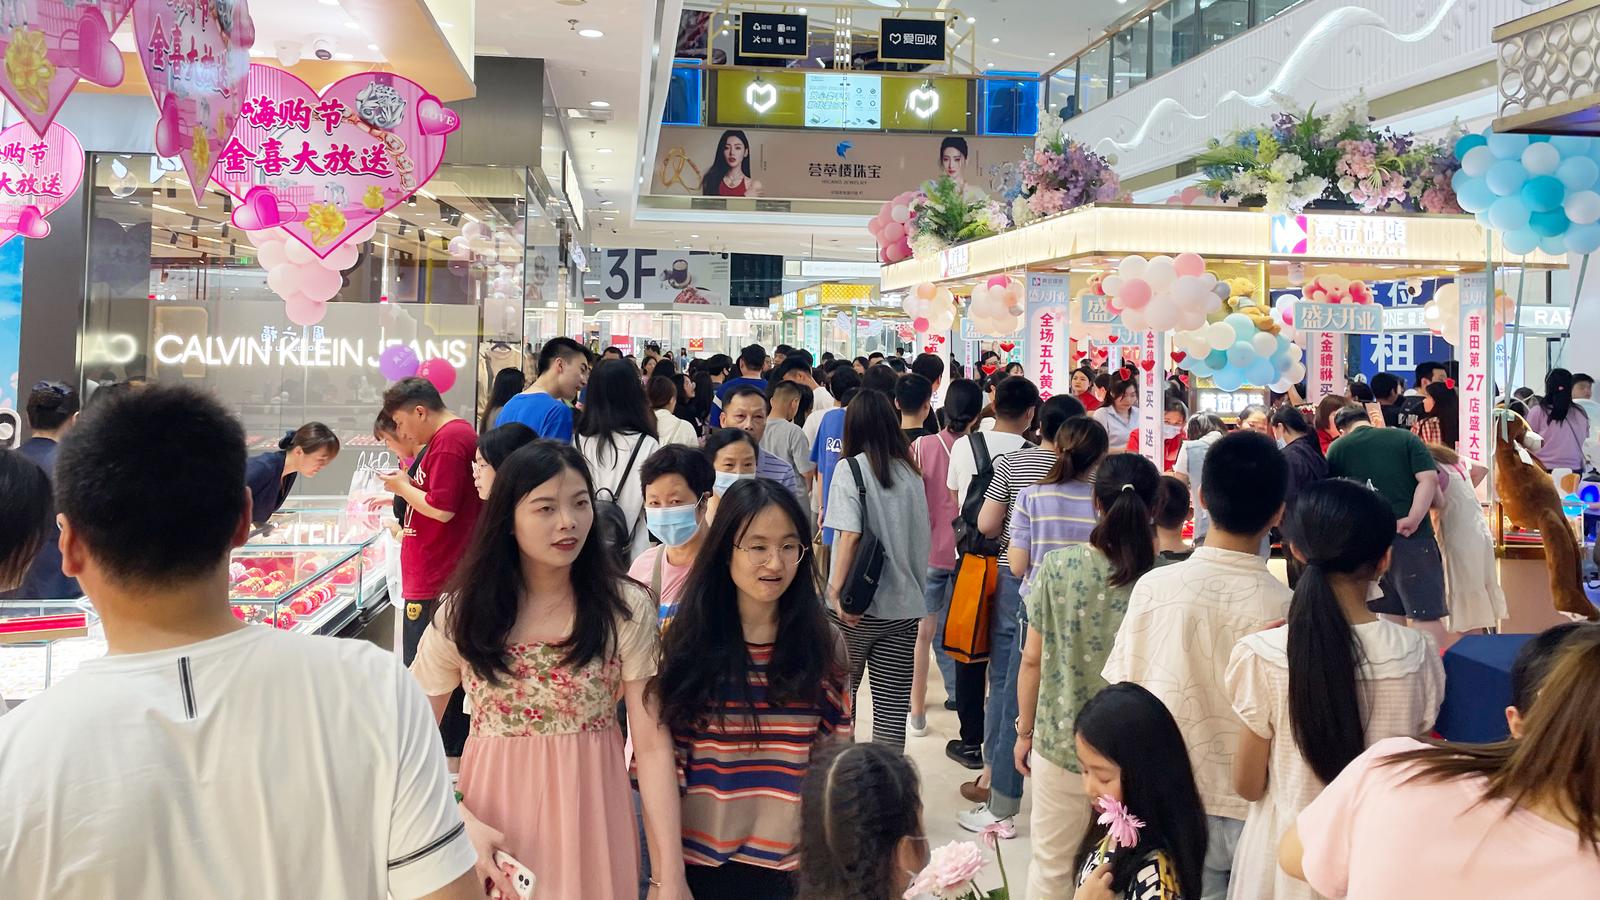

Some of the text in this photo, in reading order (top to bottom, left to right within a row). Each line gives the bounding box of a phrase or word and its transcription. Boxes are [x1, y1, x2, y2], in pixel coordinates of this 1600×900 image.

[902, 33, 938, 46] 爱回收
[0, 141, 49, 168] 购节
[217, 136, 394, 178] 金喜大放送
[0, 171, 64, 198] 大放送
[604, 248, 657, 300] 3F
[1302, 305, 1375, 331] 盛大开业
[154, 334, 271, 366] CALVIN
[279, 336, 364, 367] KLEIN
[1370, 332, 1418, 373] 租
[825, 436, 843, 453] RA
